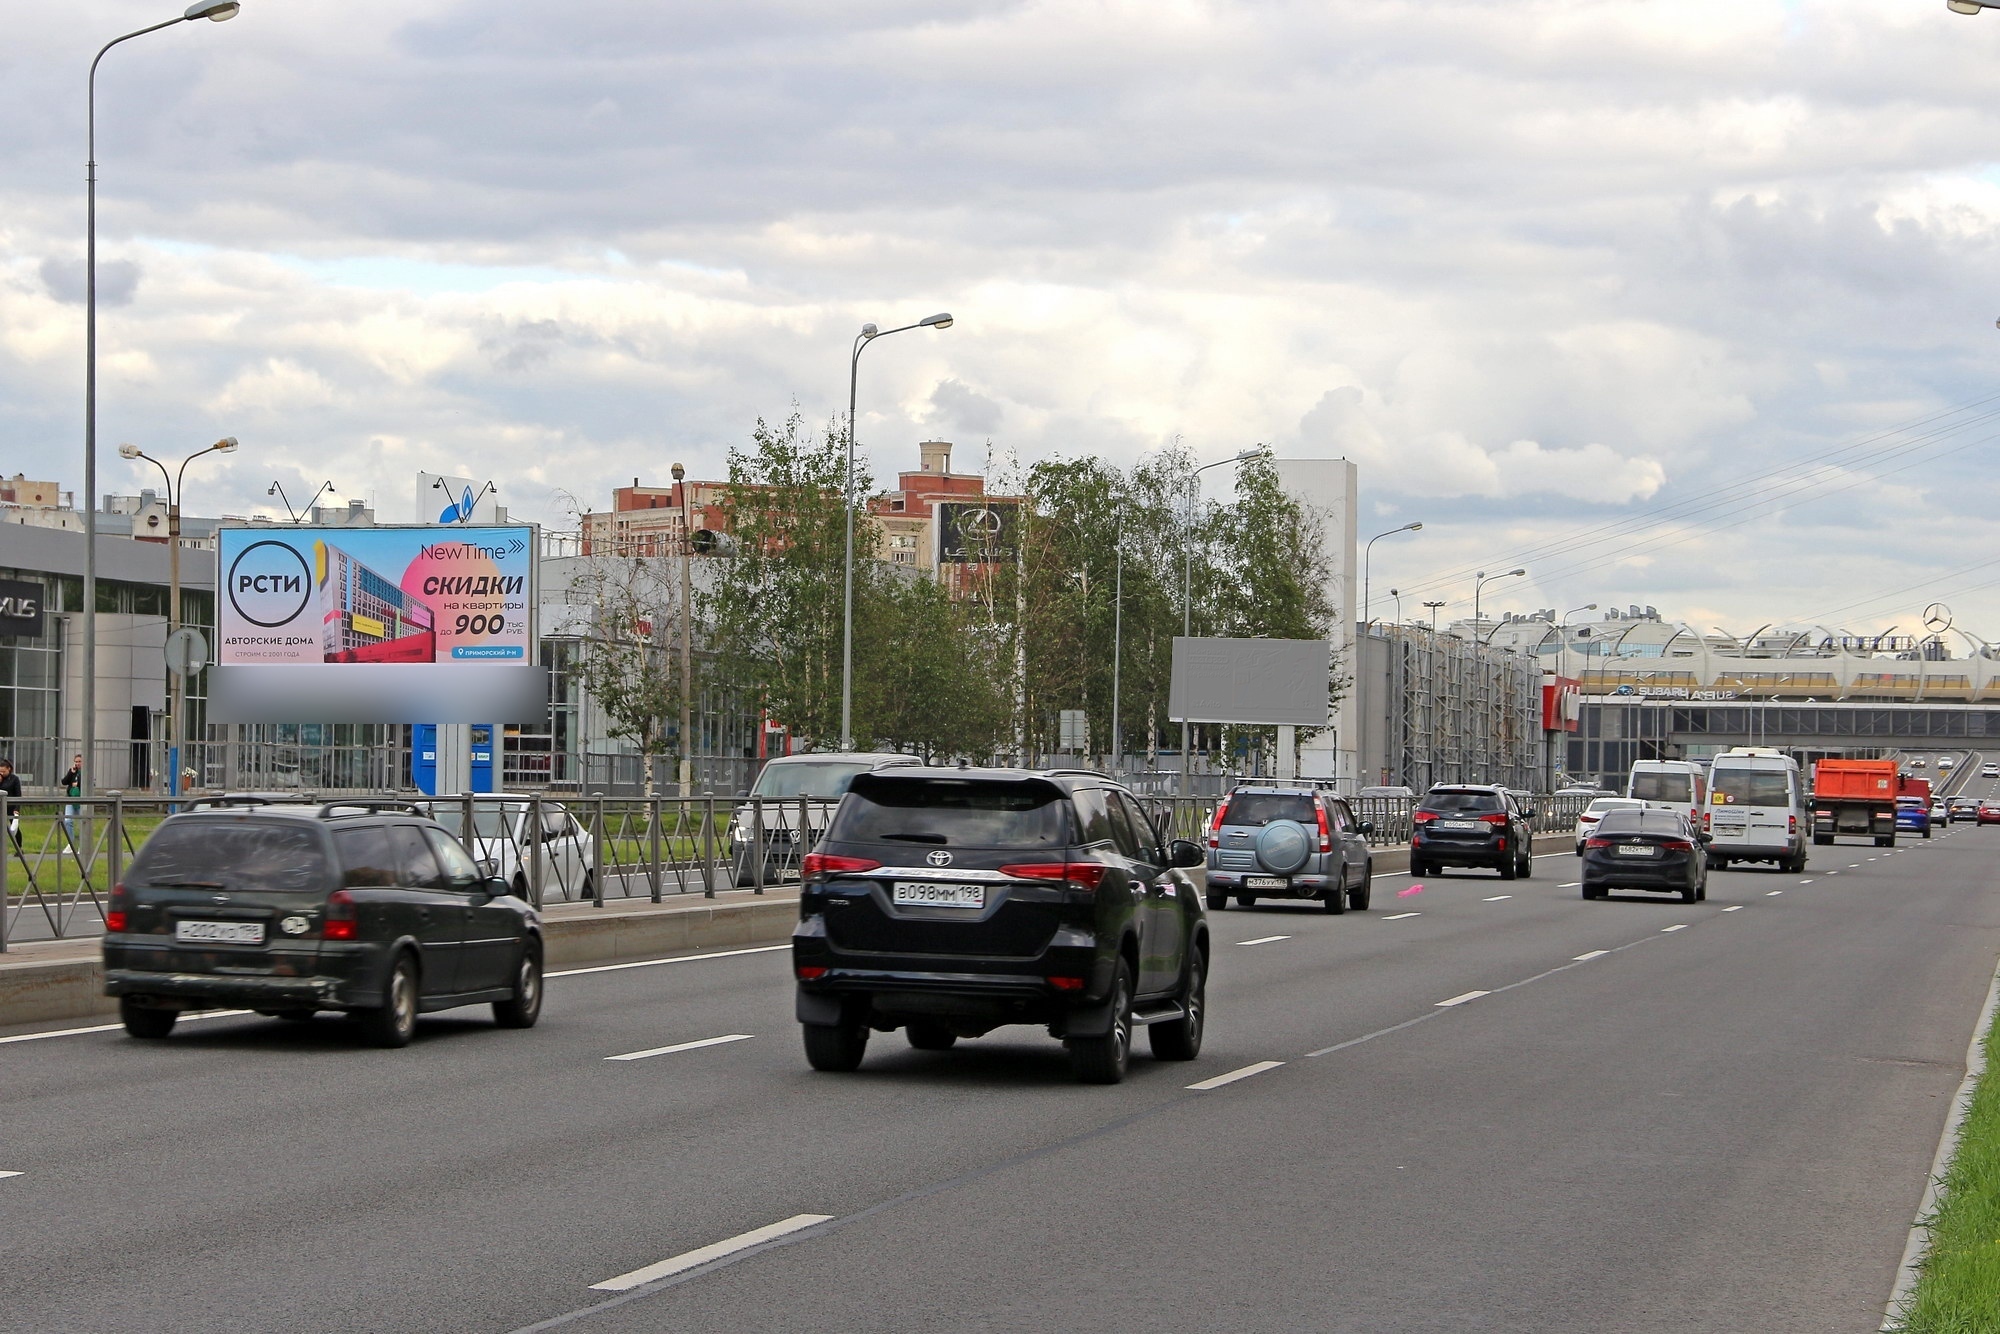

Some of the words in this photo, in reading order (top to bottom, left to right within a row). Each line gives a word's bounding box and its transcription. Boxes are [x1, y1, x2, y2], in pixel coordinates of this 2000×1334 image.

[421, 543, 506, 560] NewTime
[239, 575, 300, 593] РСТИ
[423, 576, 524, 597] СКИДКИ
[444, 602, 459, 610] на
[462, 602, 524, 611] квартиры
[455, 614, 505, 635] 900
[225, 637, 282, 645] АВТОРСКИЕ
[285, 637, 314, 646] ДОМА
[465, 648, 506, 656] ПРИМОРСКИЙ
[899, 885, 955, 901] В098ММ
[958, 887, 980, 898] 198
